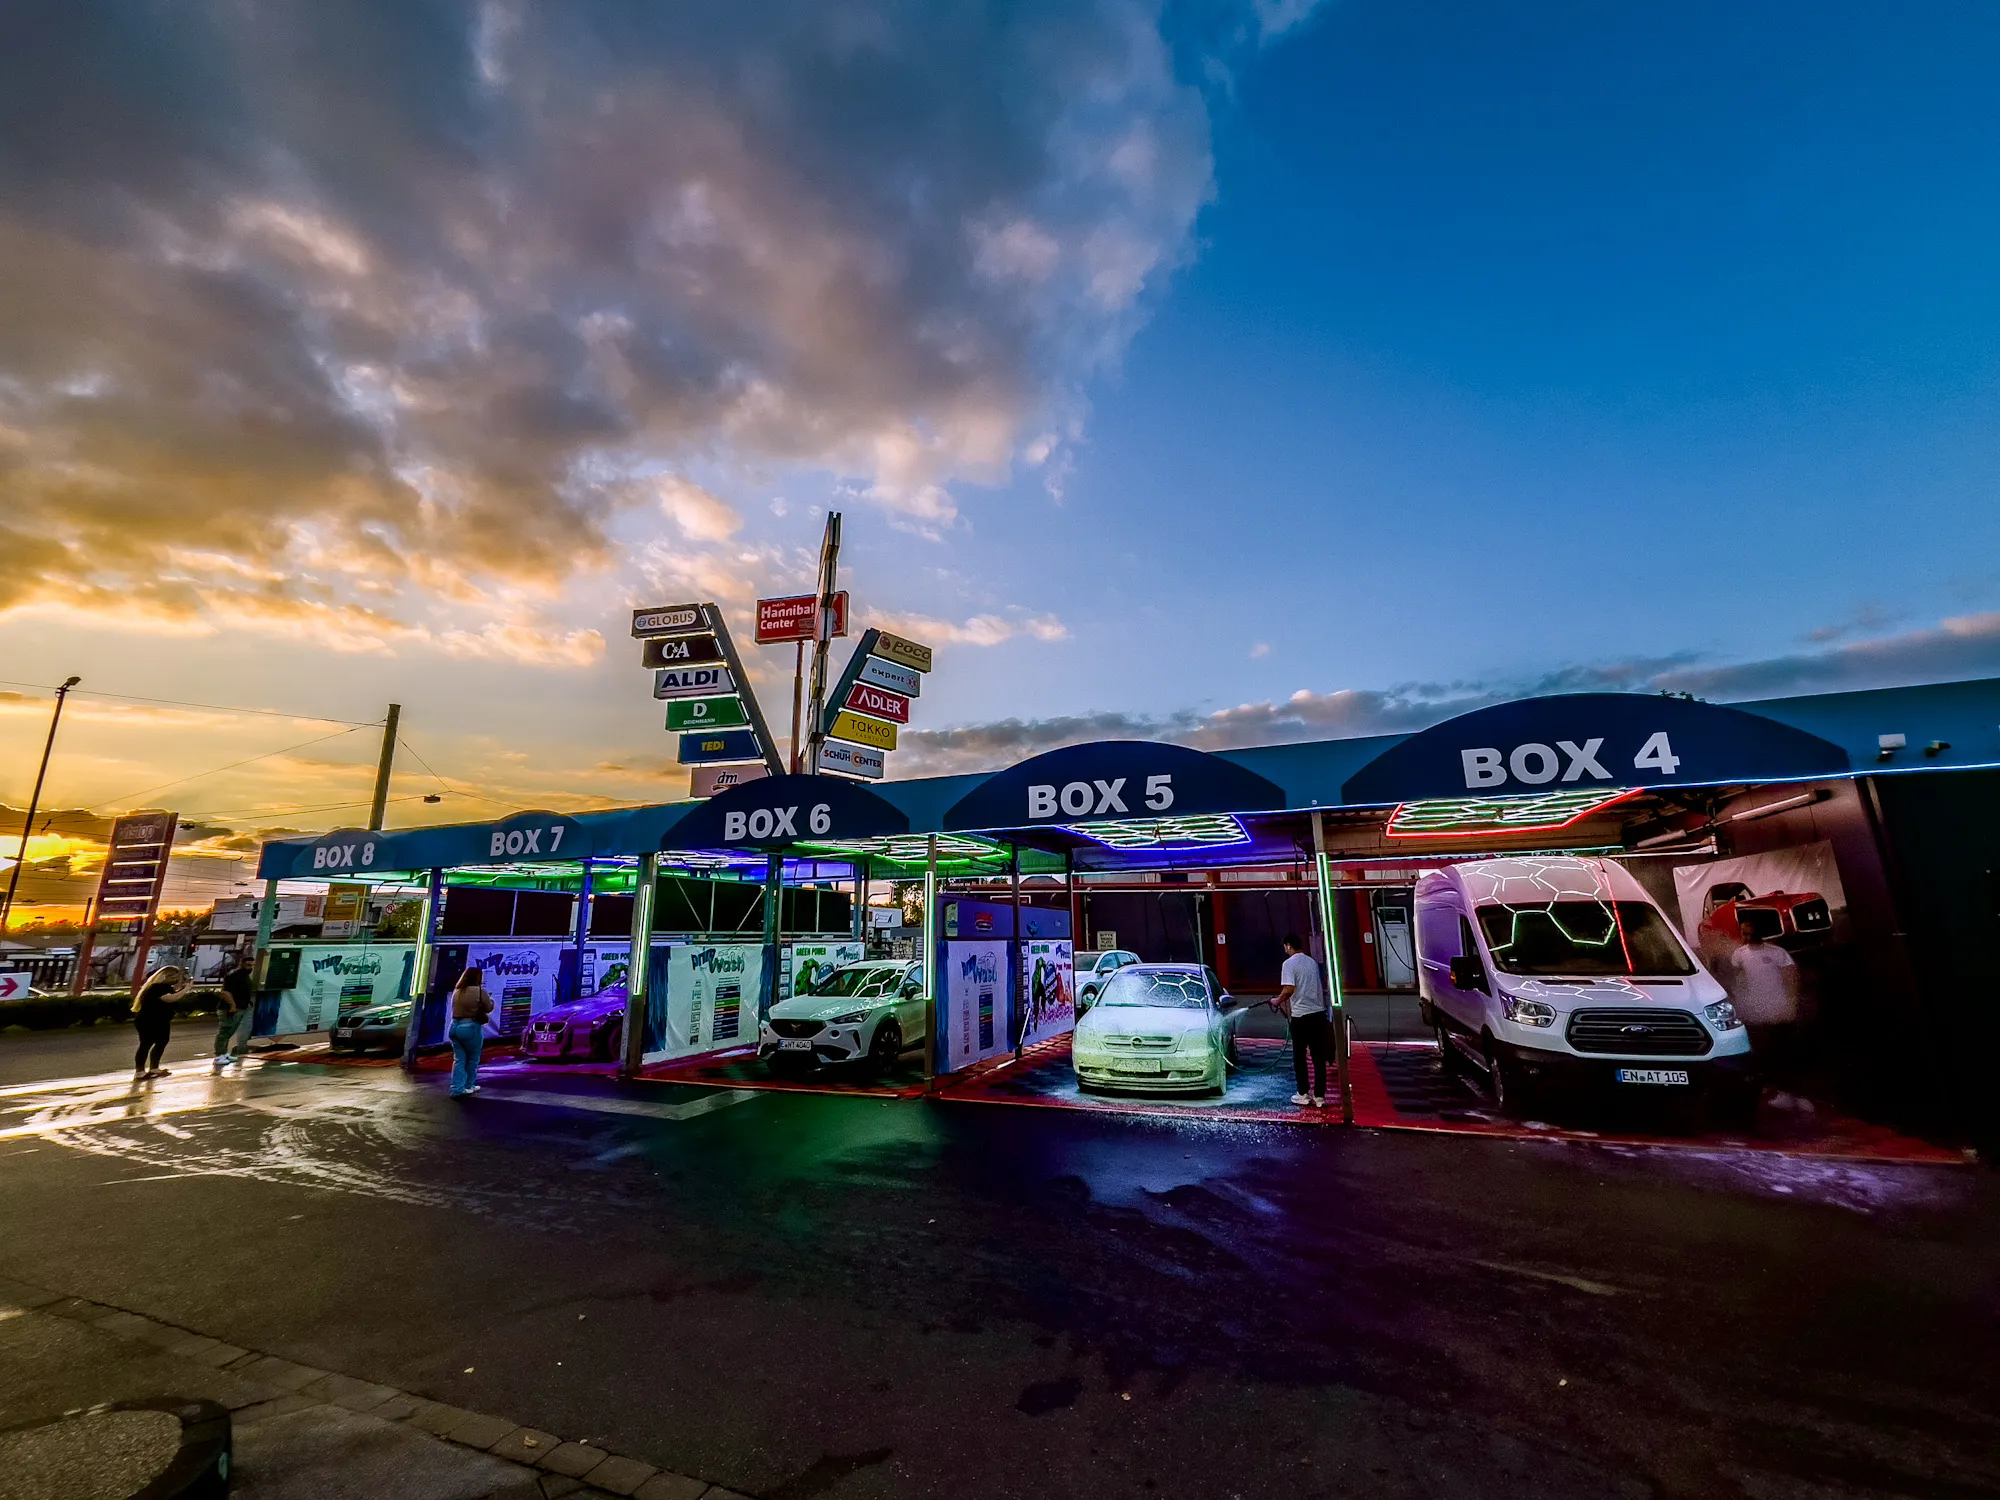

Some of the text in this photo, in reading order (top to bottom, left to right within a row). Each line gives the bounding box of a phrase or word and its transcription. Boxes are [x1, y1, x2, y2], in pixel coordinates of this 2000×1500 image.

[648, 612, 693, 626] GLOBUS
[761, 603, 815, 619] Hannibal
[760, 619, 795, 630] Center
[662, 641, 690, 659] C&A
[661, 669, 719, 688] ALDI
[871, 667, 905, 683] expert
[693, 703, 707, 717] D
[858, 688, 901, 714] ADLER
[824, 749, 882, 768] SCHUH CENTER
[1461, 732, 1680, 788] BOX 4
[717, 771, 738, 784] dm
[1028, 774, 1174, 818] BOX 5
[725, 804, 831, 840] BOX 6
[490, 826, 564, 857] BOX 7
[314, 842, 375, 869] BOX 8
[796, 947, 811, 956] GREEN
[812, 947, 826, 956] POWER
[1622, 1070, 1687, 1083] EN AT 105
